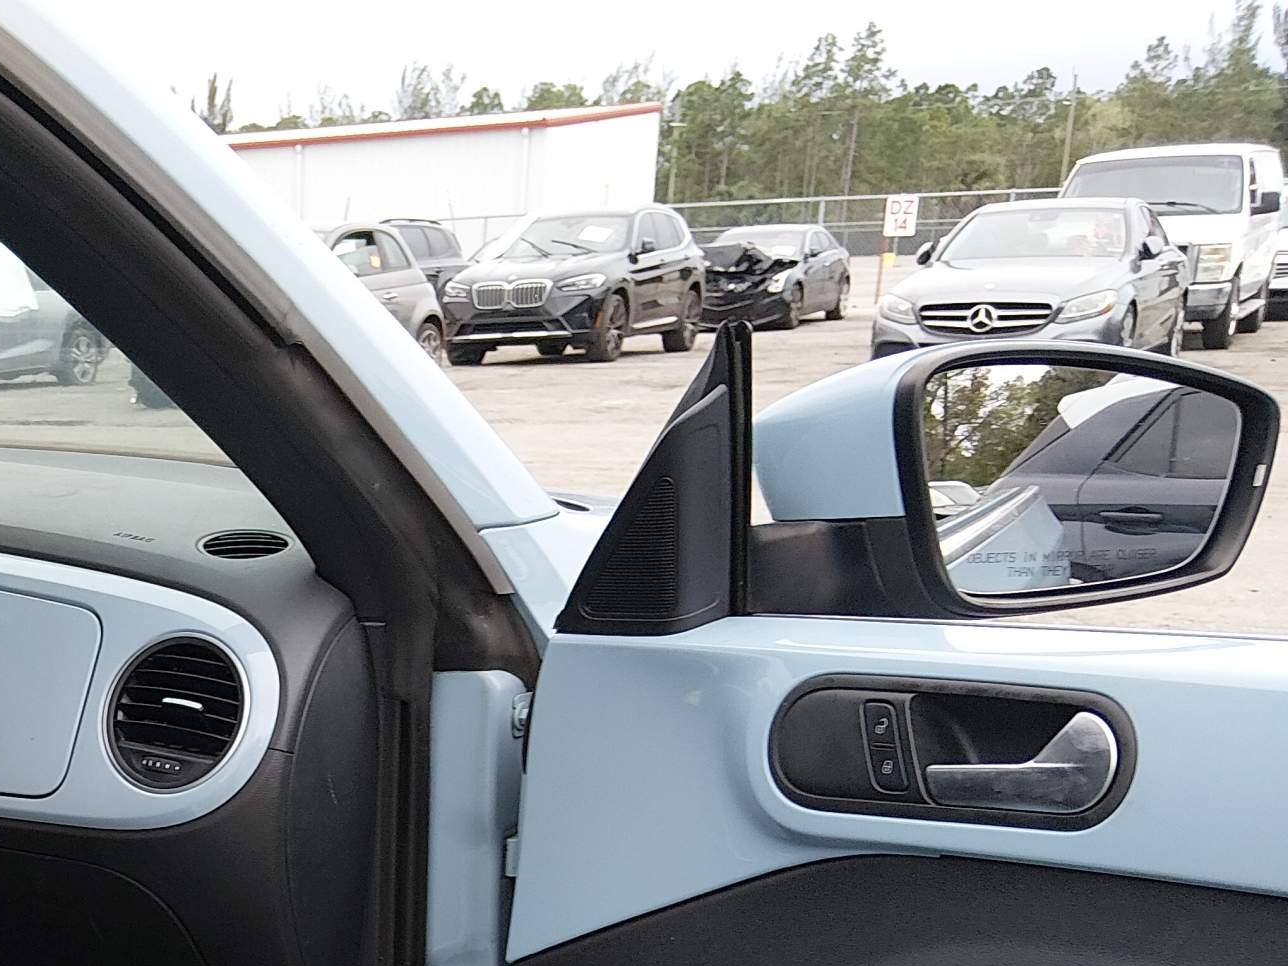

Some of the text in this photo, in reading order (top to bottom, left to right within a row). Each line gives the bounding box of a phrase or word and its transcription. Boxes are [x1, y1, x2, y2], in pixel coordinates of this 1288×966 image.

[890, 200, 914, 215] DZ
[894, 218, 908, 232] 14
[966, 551, 1017, 564] OBJECTS
[1023, 551, 1037, 563] IN
